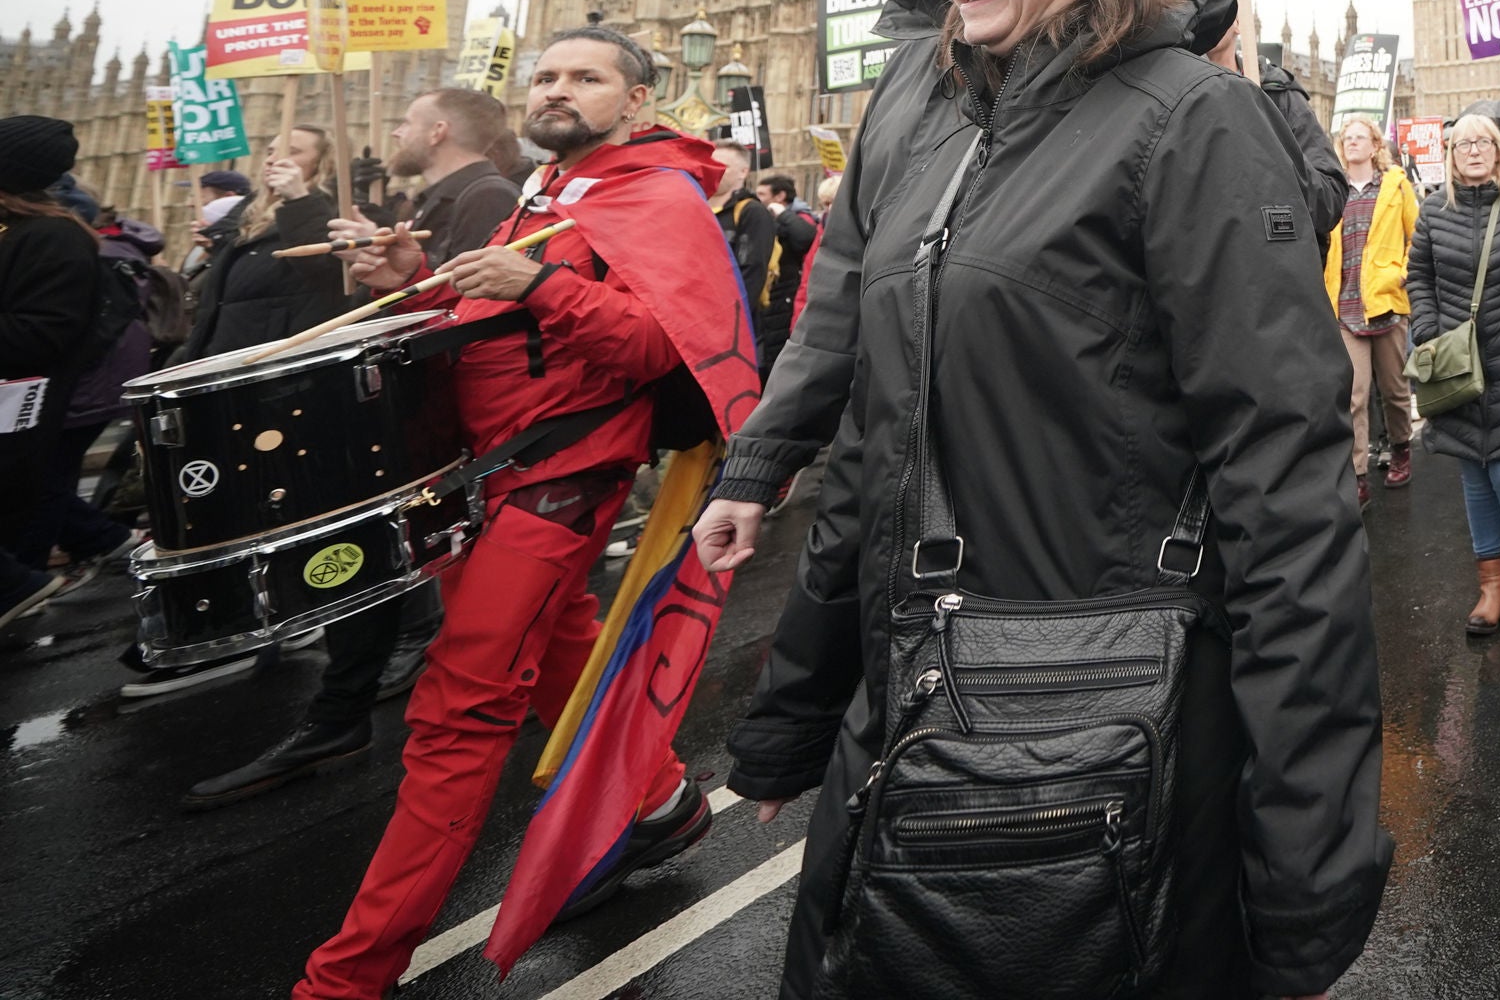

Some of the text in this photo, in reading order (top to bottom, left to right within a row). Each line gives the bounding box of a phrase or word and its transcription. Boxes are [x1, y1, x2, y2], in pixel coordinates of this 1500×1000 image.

[216, 19, 306, 40] UNITE THE
[224, 34, 302, 54] PROTEST
[13, 383, 41, 430] TORIE
